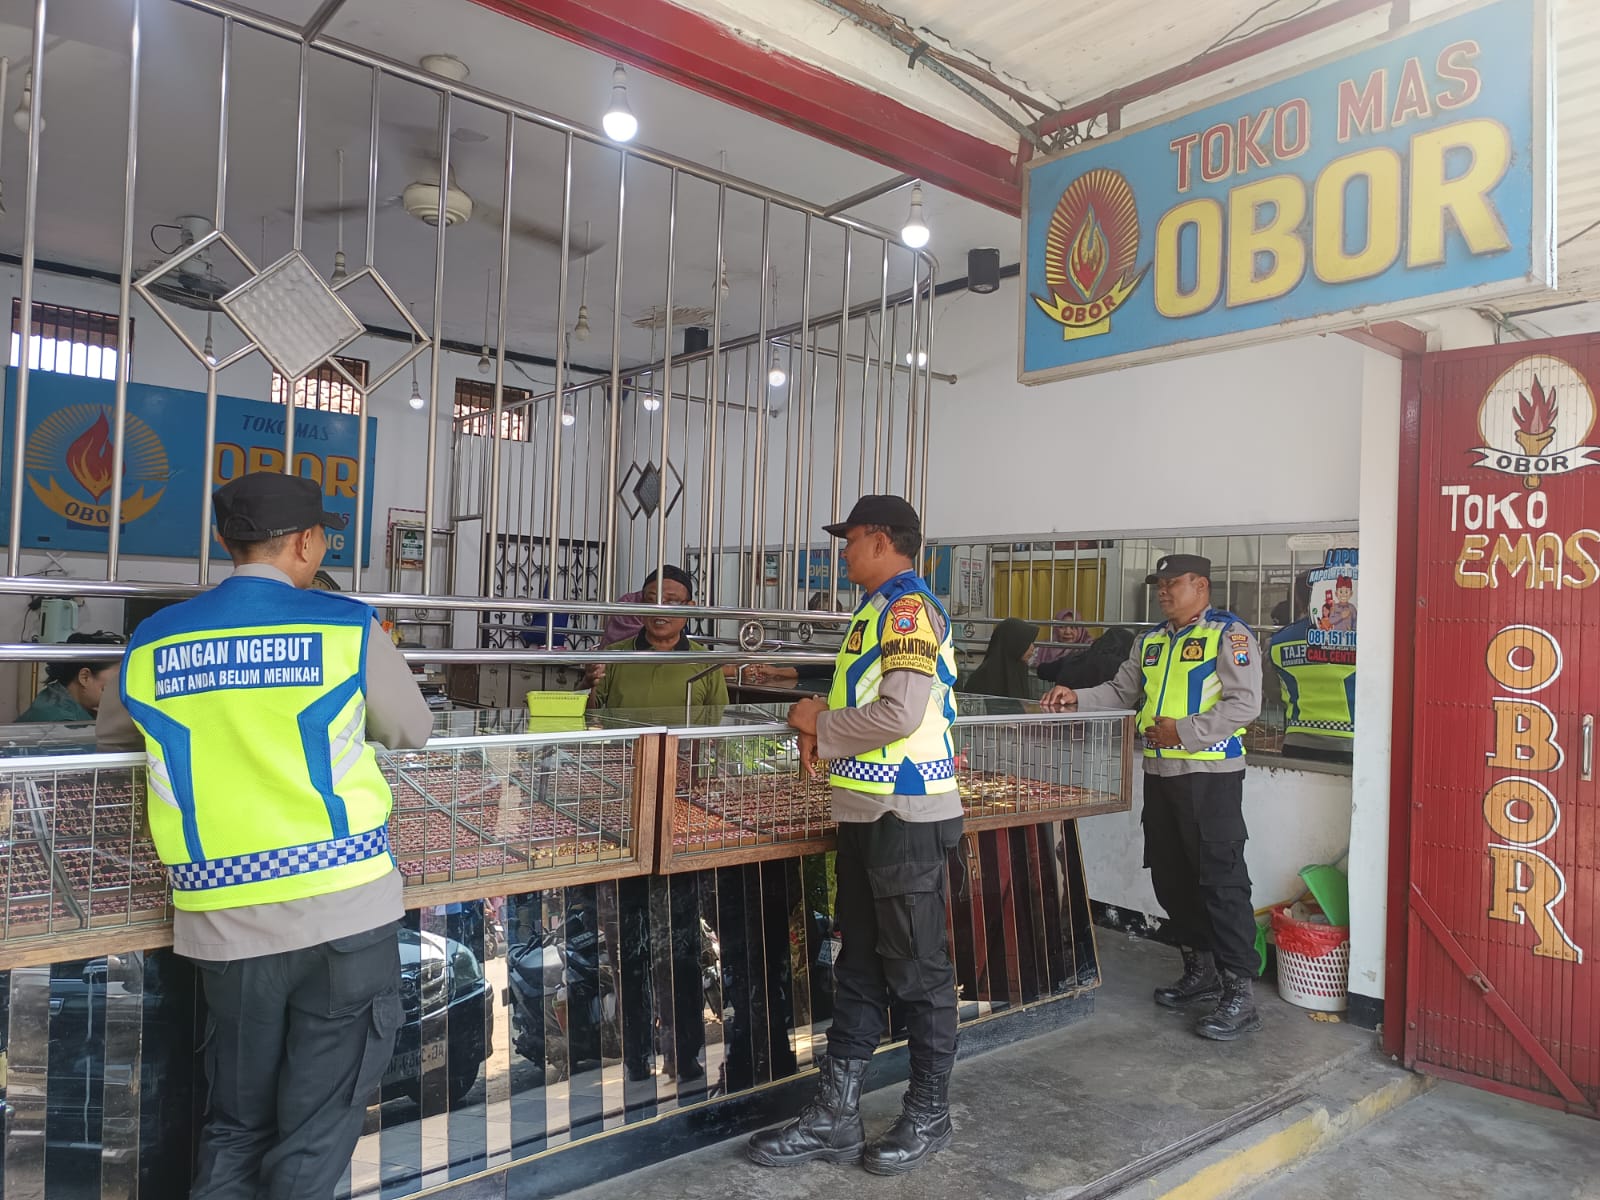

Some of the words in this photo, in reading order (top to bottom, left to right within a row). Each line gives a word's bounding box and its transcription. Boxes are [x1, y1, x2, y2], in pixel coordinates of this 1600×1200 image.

[1169, 97, 1311, 193] TOKO
[1337, 39, 1483, 143] MAS
[1153, 117, 1512, 319] OBOR
[1061, 295, 1118, 322] OBOR
[242, 415, 287, 437] TOKO
[293, 422, 329, 441] MAS
[1496, 455, 1569, 473] OBOR
[64, 502, 125, 524] OBO
[1441, 485, 1548, 532] TOKO
[1454, 529, 1600, 591] EMAS
[1308, 630, 1325, 646] 081
[1328, 630, 1342, 645] 151
[157, 640, 229, 674] JANGAN
[236, 637, 313, 666] NGEBUT
[1308, 648, 1328, 662] CALL
[156, 676, 186, 697] INGAT
[187, 672, 217, 691] ANDA
[219, 668, 260, 687] BELUM
[264, 666, 320, 684] MENIKAH
[1482, 623, 1584, 965] OBOR
